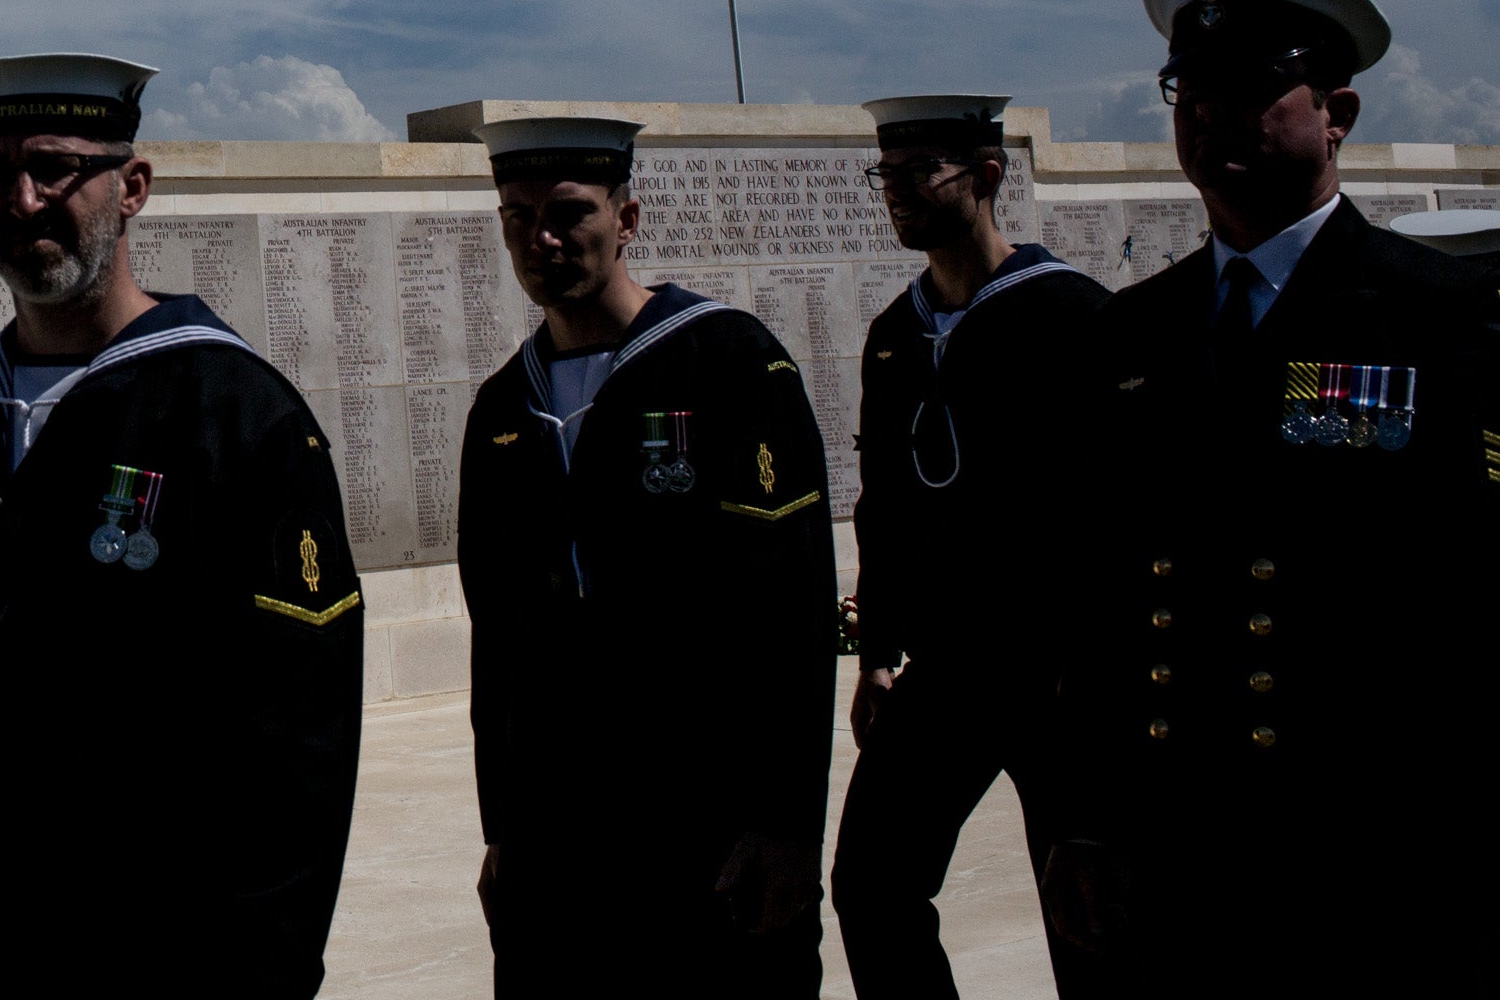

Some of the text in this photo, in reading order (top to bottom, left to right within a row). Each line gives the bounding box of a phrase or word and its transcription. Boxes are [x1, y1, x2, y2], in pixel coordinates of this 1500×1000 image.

[72, 104, 107, 118] NAVY
[631, 161, 645, 173] OF
[654, 160, 676, 173] GOD
[685, 160, 707, 172] AND
[716, 160, 726, 171] IN
[734, 160, 778, 171] LASTING
[785, 159, 827, 171] MEMORY
[835, 159, 847, 171] OF
[674, 177, 685, 189] IN
[693, 177, 709, 189] 1915
[717, 177, 739, 188] AND
[747, 176, 781, 188] HAVE
[784, 176, 799, 187] NO
[807, 175, 847, 187] KNOWN
[639, 195, 676, 207] NAMES
[685, 194, 708, 206] ARE
[717, 193, 738, 205] NOT
[747, 193, 799, 205] RECORDED
[807, 193, 818, 204] IN
[825, 192, 859, 203] OTHER
[1009, 190, 1025, 200] BUT
[645, 205, 1008, 224] THE ANZAC AREA AND HAVE NO KNOWN OF
[139, 221, 234, 230] AUSTRALIAN INFANTRY
[283, 220, 327, 228] AUSTRALIAN
[428, 226, 483, 235] 5TH BATTALION
[179, 231, 221, 239] BATTALION
[297, 229, 311, 237] 4TH
[665, 229, 687, 241] AND
[694, 228, 713, 240] 252
[720, 227, 744, 239] NEW
[753, 226, 820, 238] ZEALANDERS
[826, 225, 852, 236] WHO
[657, 246, 704, 259] MORTAL
[712, 244, 760, 256] WOUNDS
[768, 243, 782, 255] OR
[790, 242, 833, 254] SICKNESS
[842, 241, 862, 252] AND
[404, 550, 415, 560] 23
